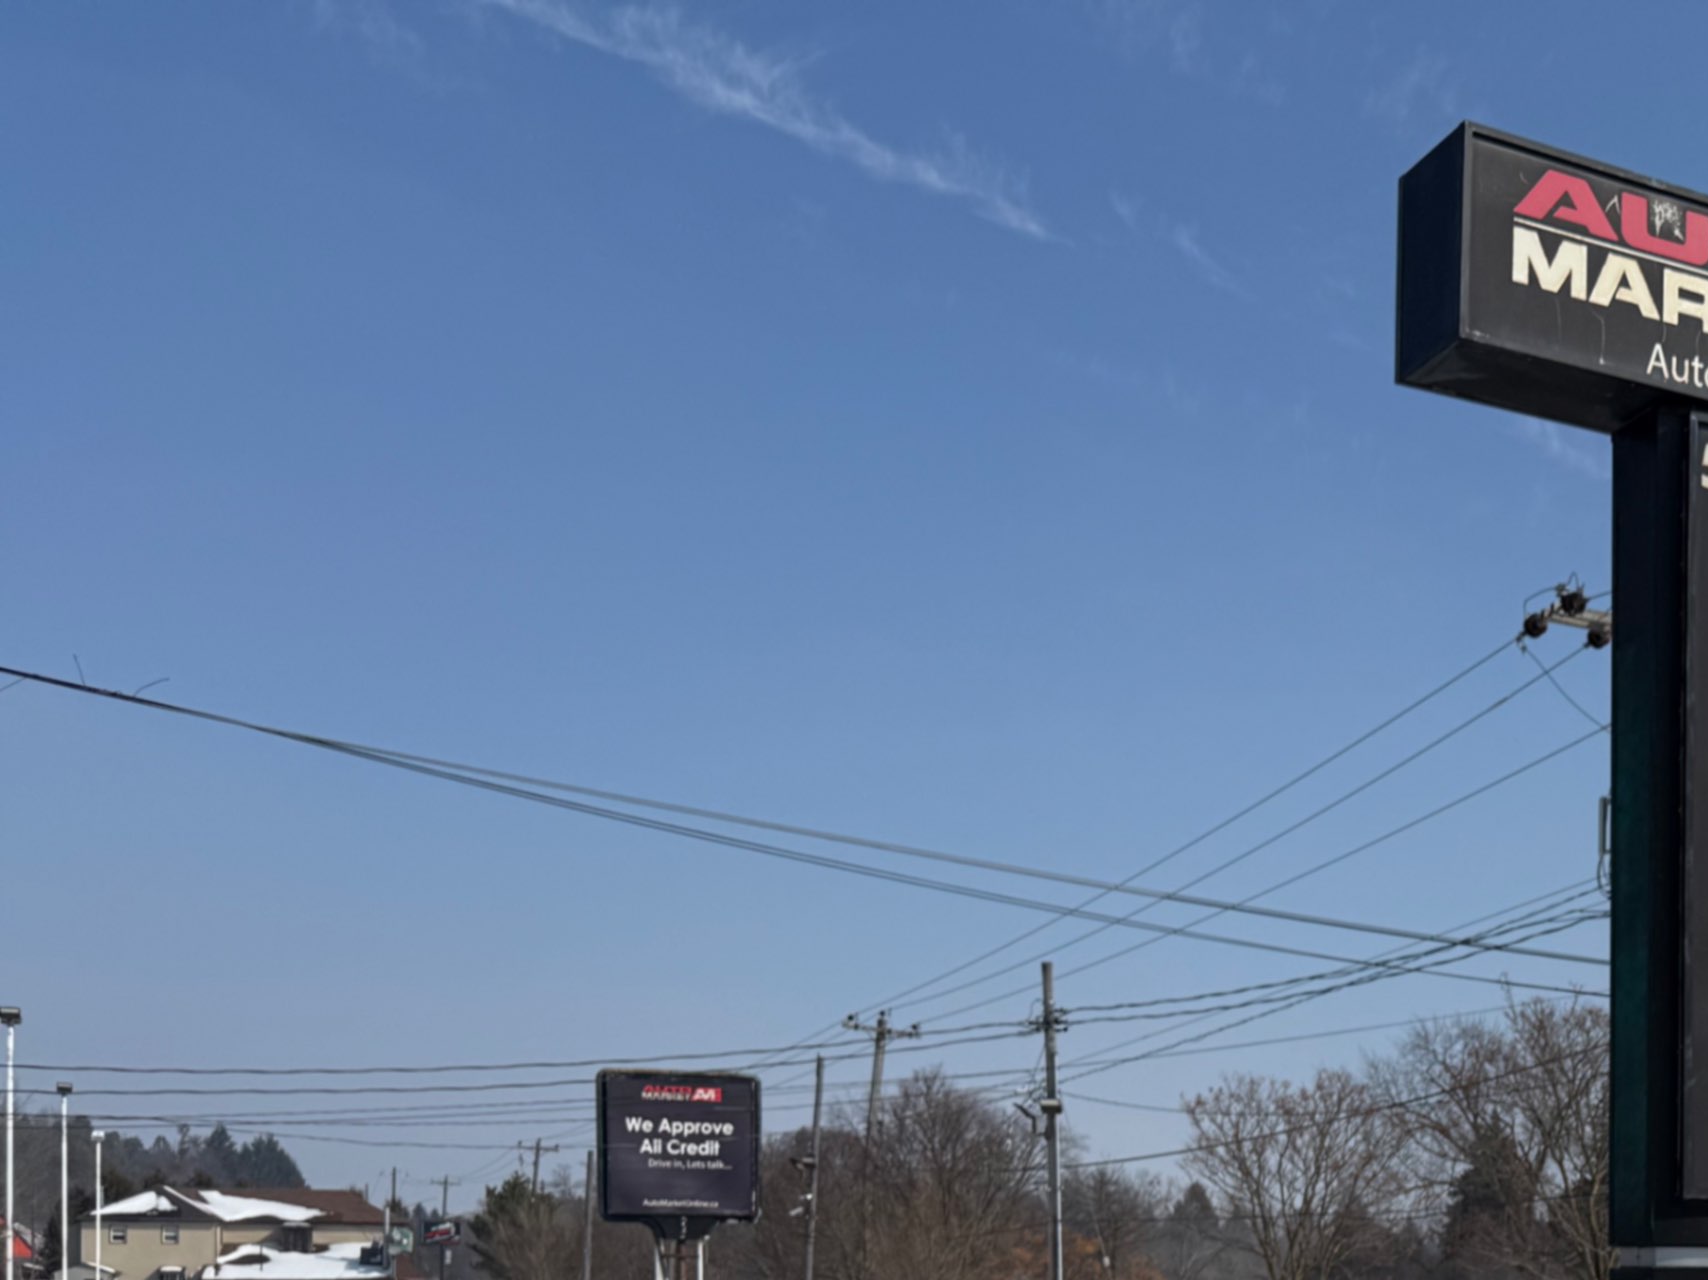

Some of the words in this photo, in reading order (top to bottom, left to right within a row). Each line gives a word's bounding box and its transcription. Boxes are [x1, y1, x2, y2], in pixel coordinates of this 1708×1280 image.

[624, 1116, 654, 1134] We
[658, 1117, 735, 1137] Approve
[640, 1138, 663, 1155] All
[666, 1139, 720, 1156] Credit
[648, 1158, 672, 1169] Drive
